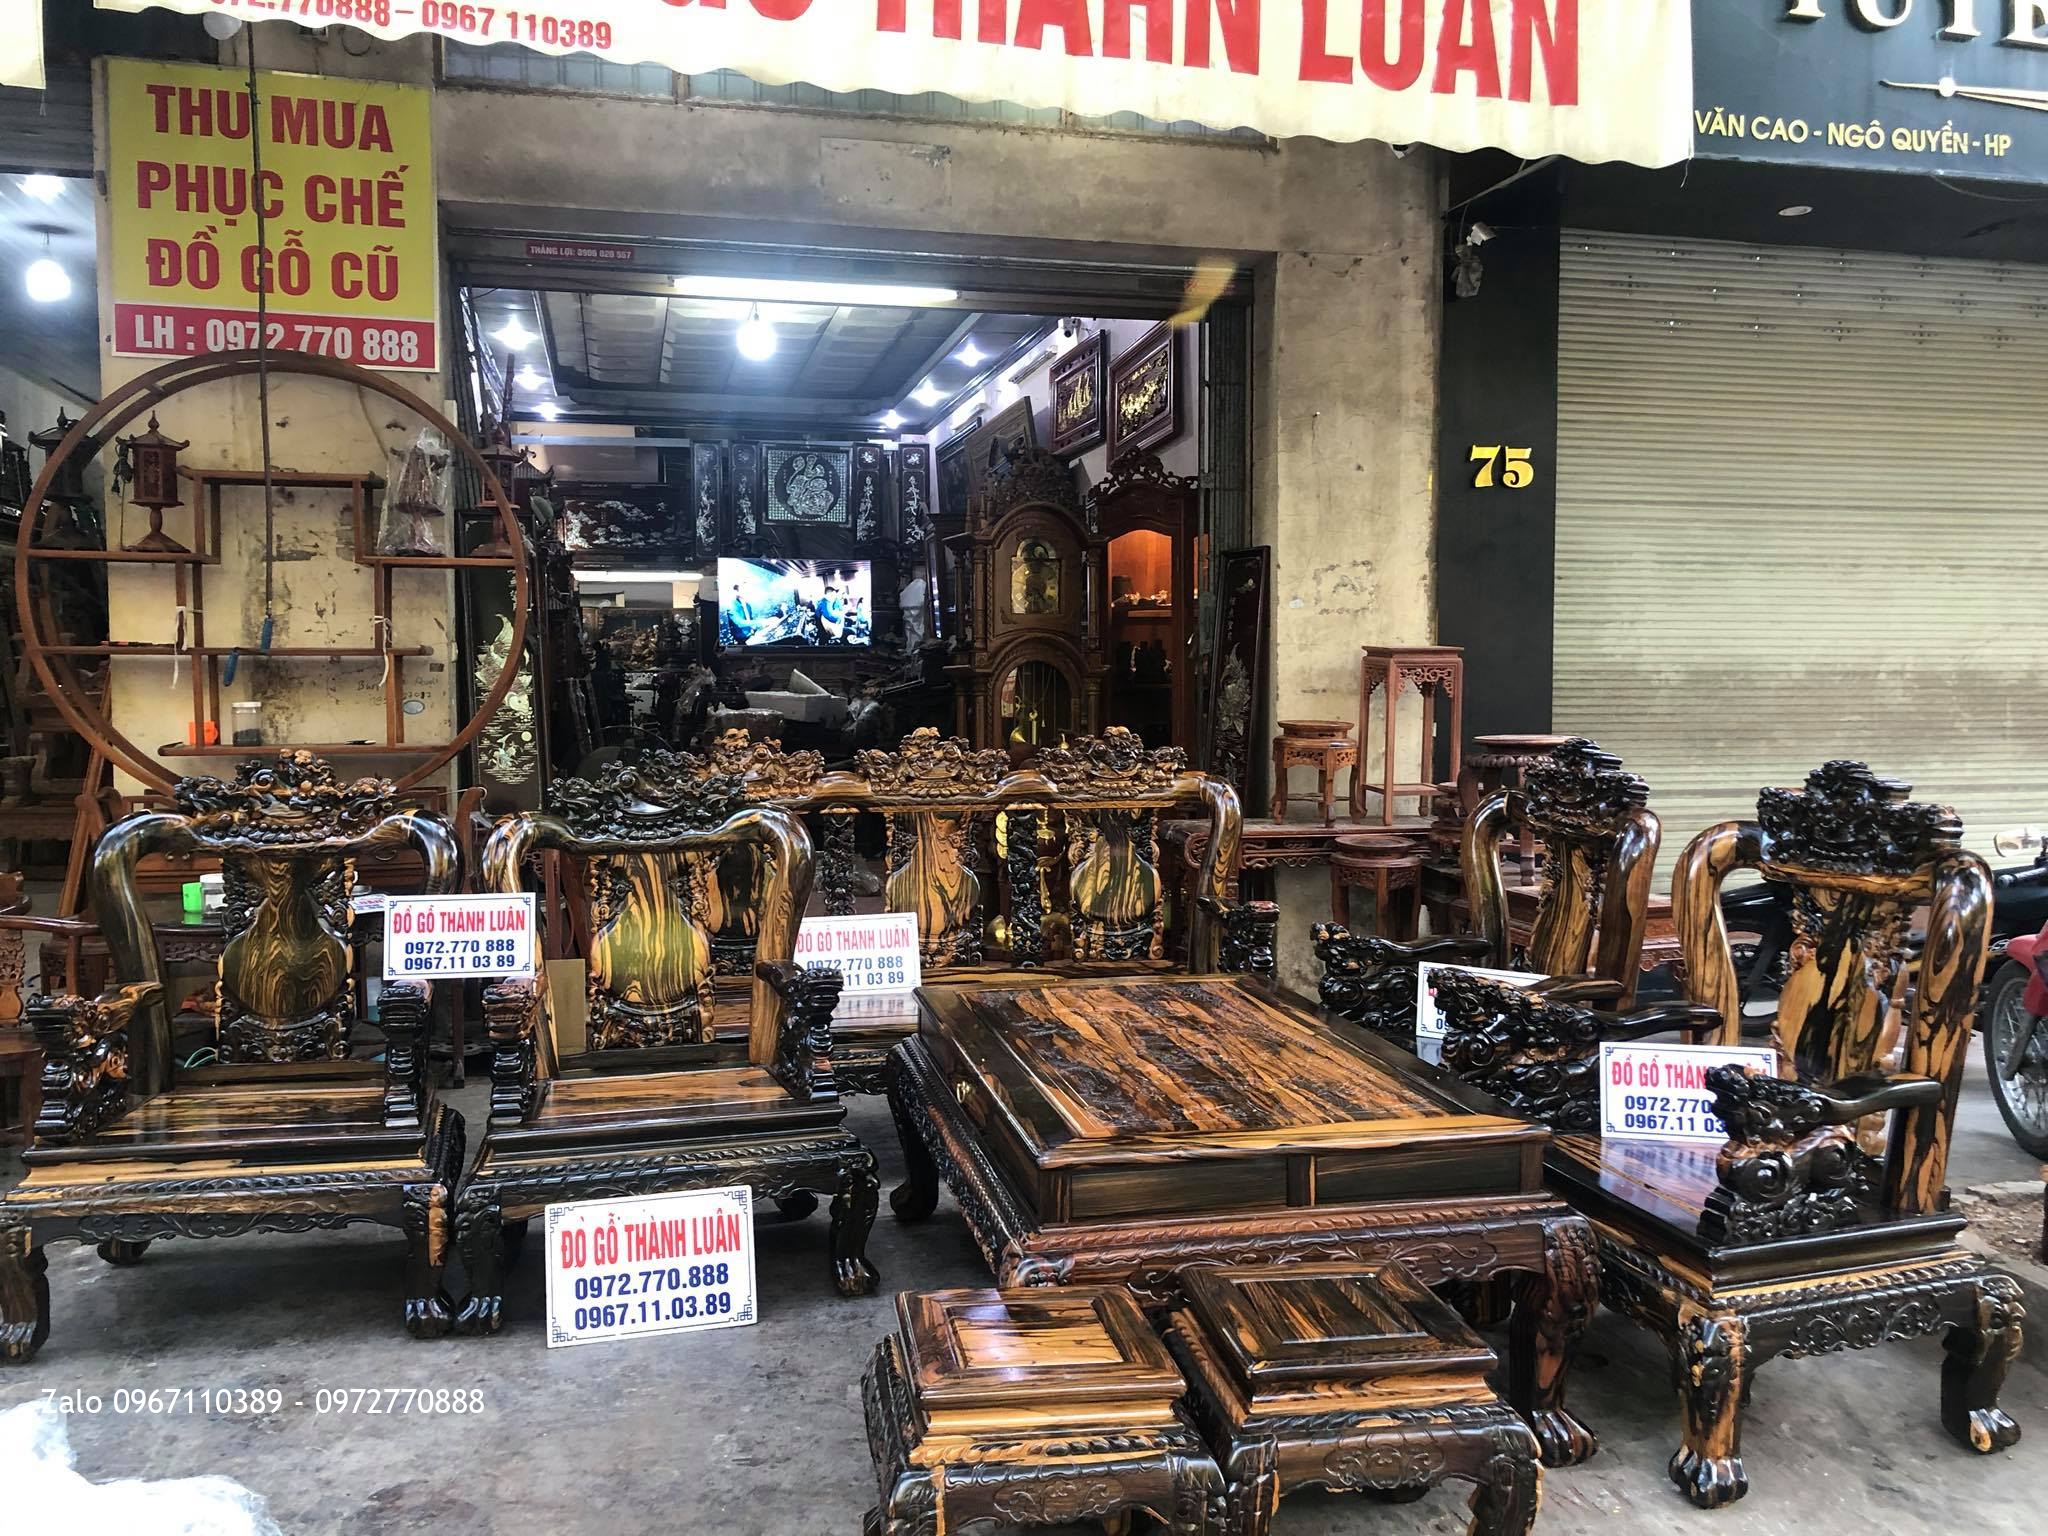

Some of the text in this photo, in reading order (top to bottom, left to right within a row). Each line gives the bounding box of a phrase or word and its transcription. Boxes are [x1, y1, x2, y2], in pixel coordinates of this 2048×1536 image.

[422, 1, 496, 35] 0967
[506, 11, 611, 49] 110389
[146, 84, 394, 152] THU MUA
[1694, 107, 1745, 138] VĂN
[1751, 116, 1808, 143] CAO
[1827, 120, 1885, 149] NGÔ
[1891, 120, 1968, 154] QUYỀN
[1985, 134, 2012, 156] HP
[137, 160, 409, 228] PHỤC CHẾ
[146, 225, 399, 301] ĐỒ GỖ CŨ
[135, 314, 175, 349] LH
[205, 318, 352, 360] 0972.770
[362, 328, 419, 362] 888
[1470, 445, 1534, 488] 75
[440, 908, 484, 932] THÀNH
[490, 906, 525, 931] LUÂN
[404, 955, 515, 970] 0967.11 03 89
[405, 939, 515, 954] 0972.770 888
[877, 956, 903, 969] 888
[867, 973, 883, 985] 03
[888, 971, 904, 984] 89
[1665, 1060, 1707, 1089] THÀN
[1624, 1095, 1712, 1114] 0972.770
[1624, 1114, 1725, 1133] 0967.11 03
[593, 1212, 618, 1265] GỖ
[624, 1215, 686, 1262] THÀNH
[692, 1208, 740, 1255] LUÂN
[574, 1263, 729, 1300] 0972.770.888
[575, 1292, 731, 1330] 0967.11.03.89
